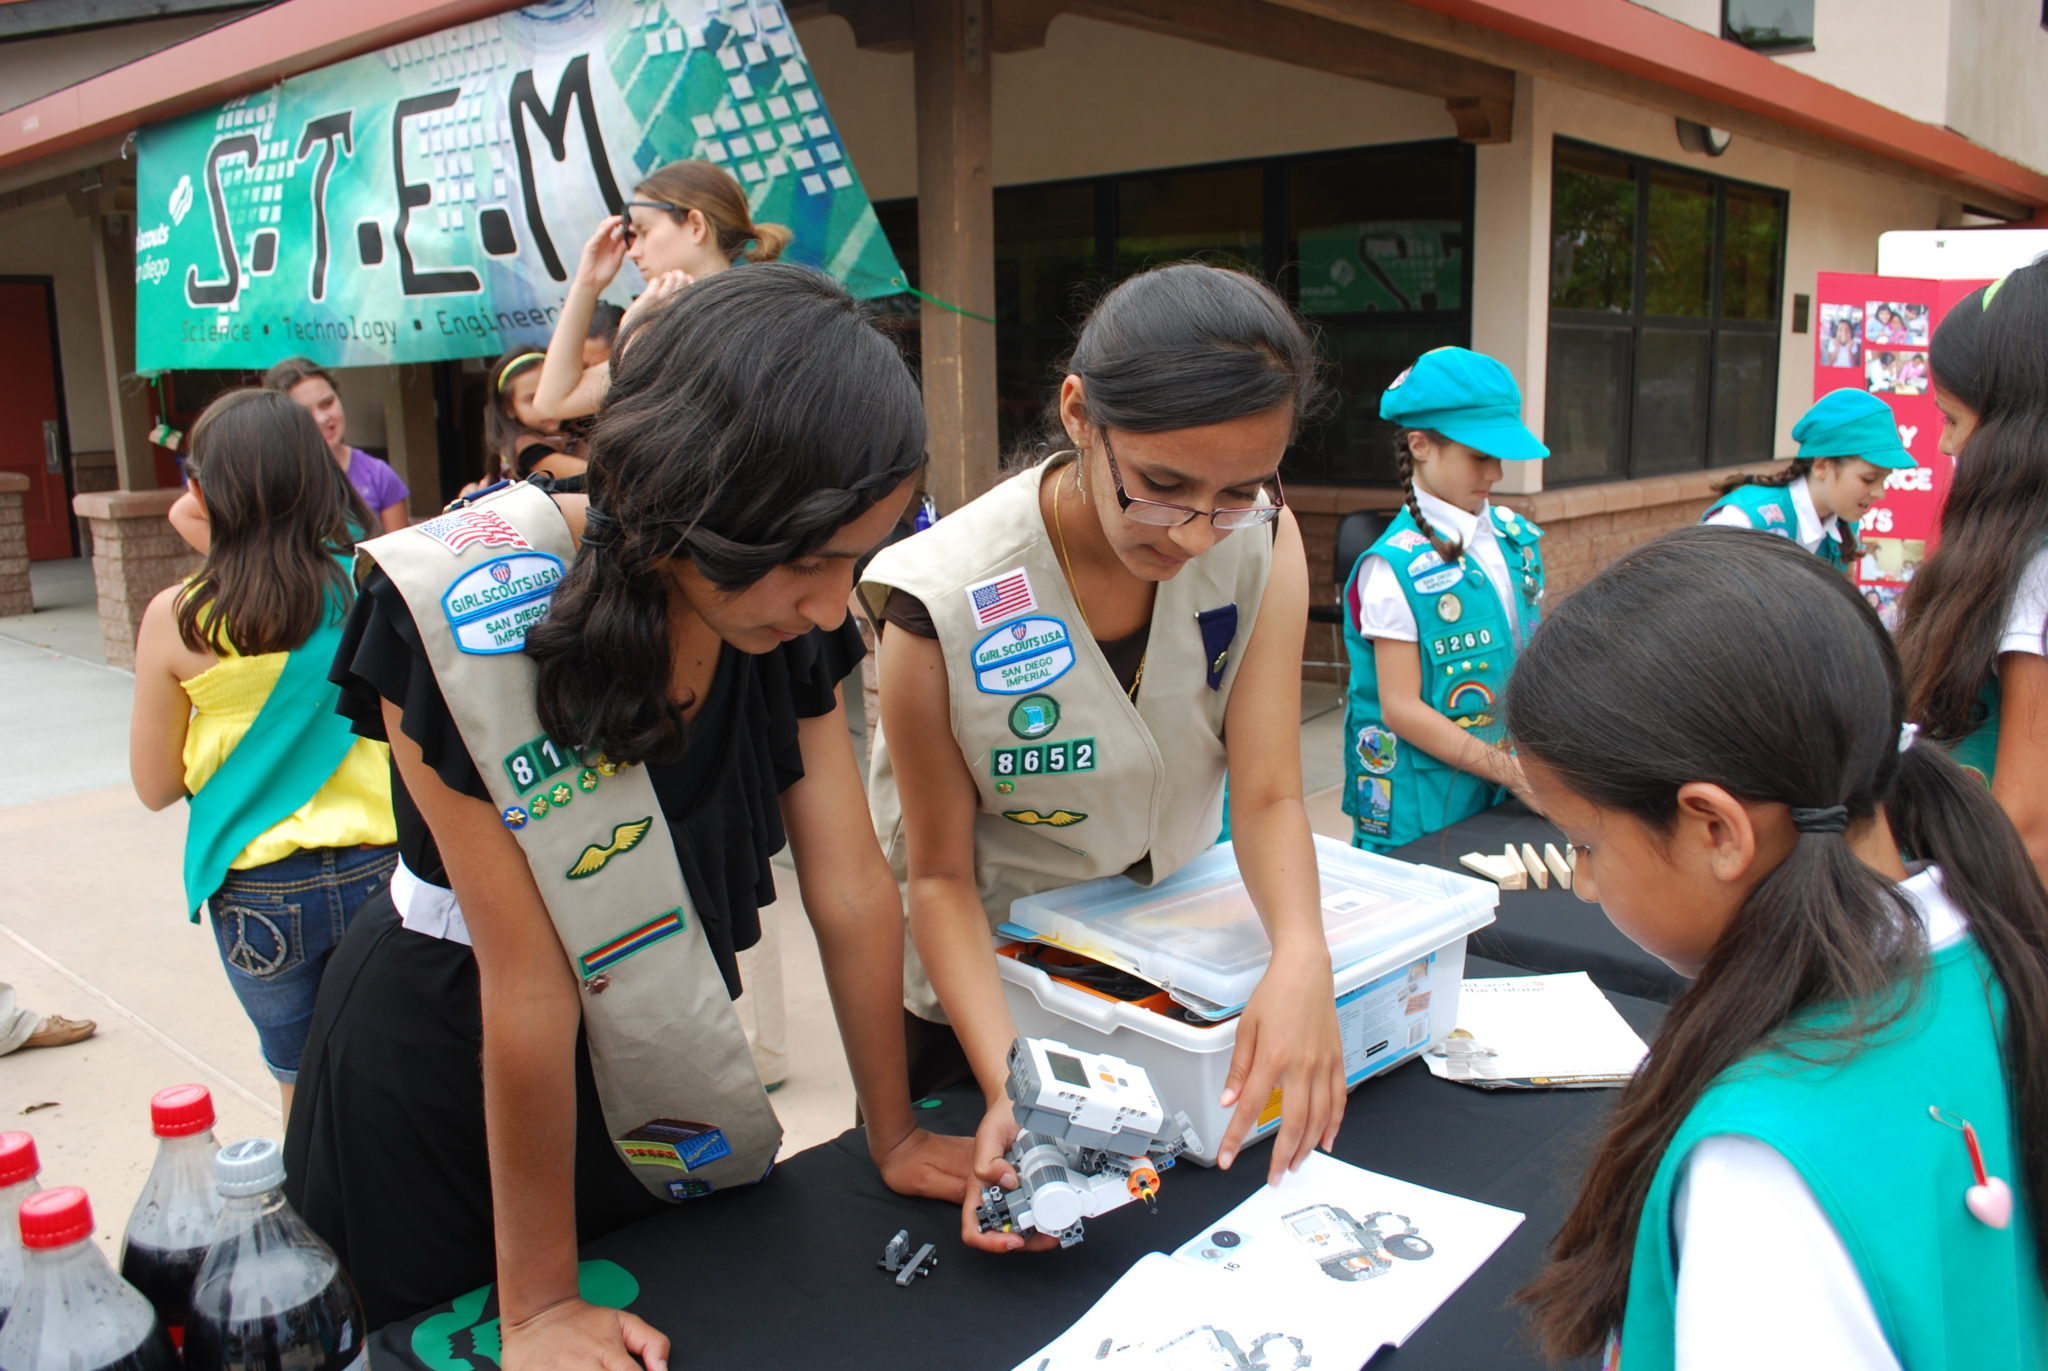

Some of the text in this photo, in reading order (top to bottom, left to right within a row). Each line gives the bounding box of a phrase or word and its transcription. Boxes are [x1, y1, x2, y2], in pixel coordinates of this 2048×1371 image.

[182, 298, 566, 344] Science Technology Engineer
[1883, 467, 1933, 491] NCE
[451, 591, 483, 613] GIRL
[481, 575, 533, 604] SCOUTS
[485, 603, 549, 634] SAN DIEGO
[494, 618, 544, 646] IMPER
[979, 646, 1002, 664] GIRL
[1001, 635, 1041, 659] SCOUTS
[1434, 629, 1491, 655] 5260
[1001, 656, 1054, 679] SAN DIEGO
[1006, 669, 1052, 688] IMPERIAL
[512, 739, 575, 786] 81
[997, 744, 1092, 775] 8652
[1223, 1261, 1241, 1273] 16
